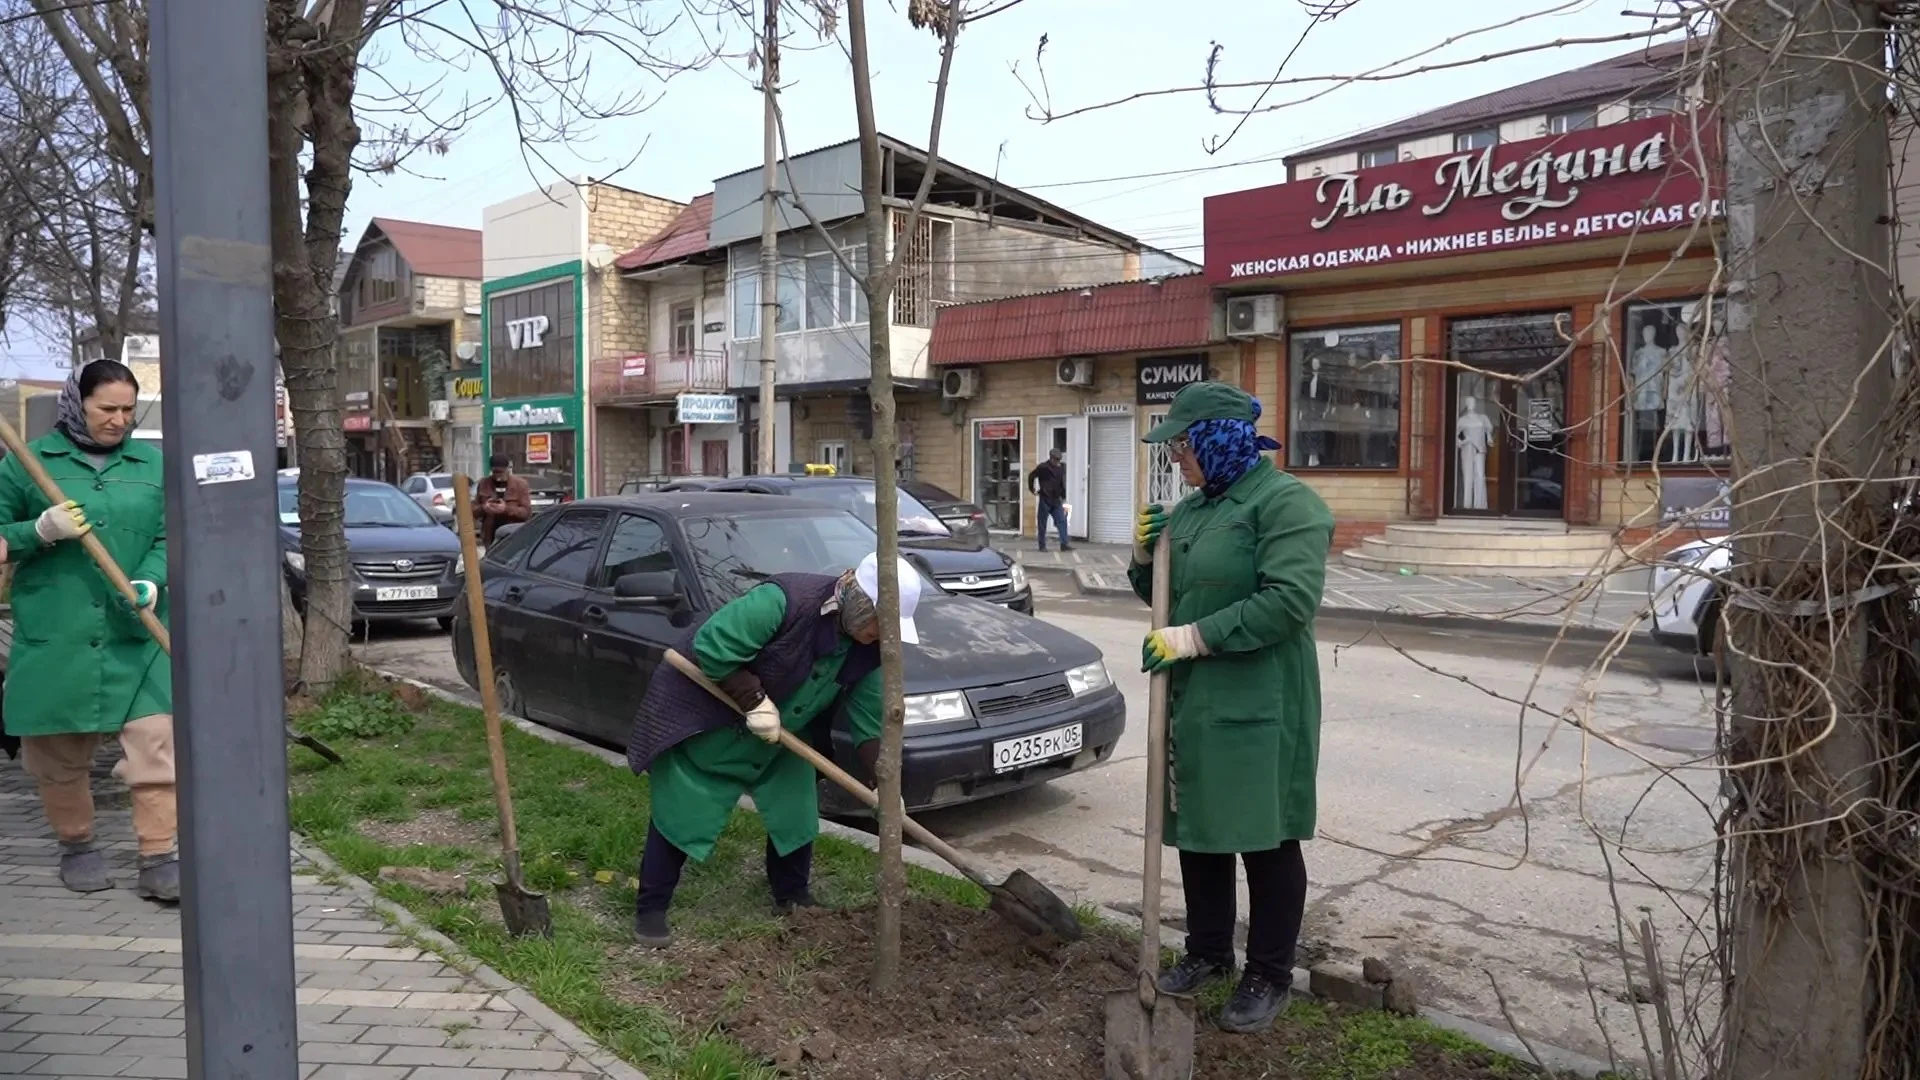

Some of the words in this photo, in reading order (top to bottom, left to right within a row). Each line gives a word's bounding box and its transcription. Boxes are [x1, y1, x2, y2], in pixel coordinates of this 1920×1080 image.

[1311, 172, 1412, 229] Аль
[1422, 132, 1666, 220] Медина
[1230, 254, 1310, 278] ЖЕНСКАЯ
[1312, 244, 1392, 267] ОДЕЖДА
[1405, 231, 1488, 255] НИЖНЕЕ
[1492, 221, 1557, 245] БЕЛЬЕ
[1573, 204, 1684, 237] ДЕТСКАЯ
[506, 315, 549, 350] VIP
[1140, 364, 1203, 385] СУМКИ
[682, 398, 736, 410] ПРОДУКТЫ
[1145, 390, 1175, 400] КАНЦТО
